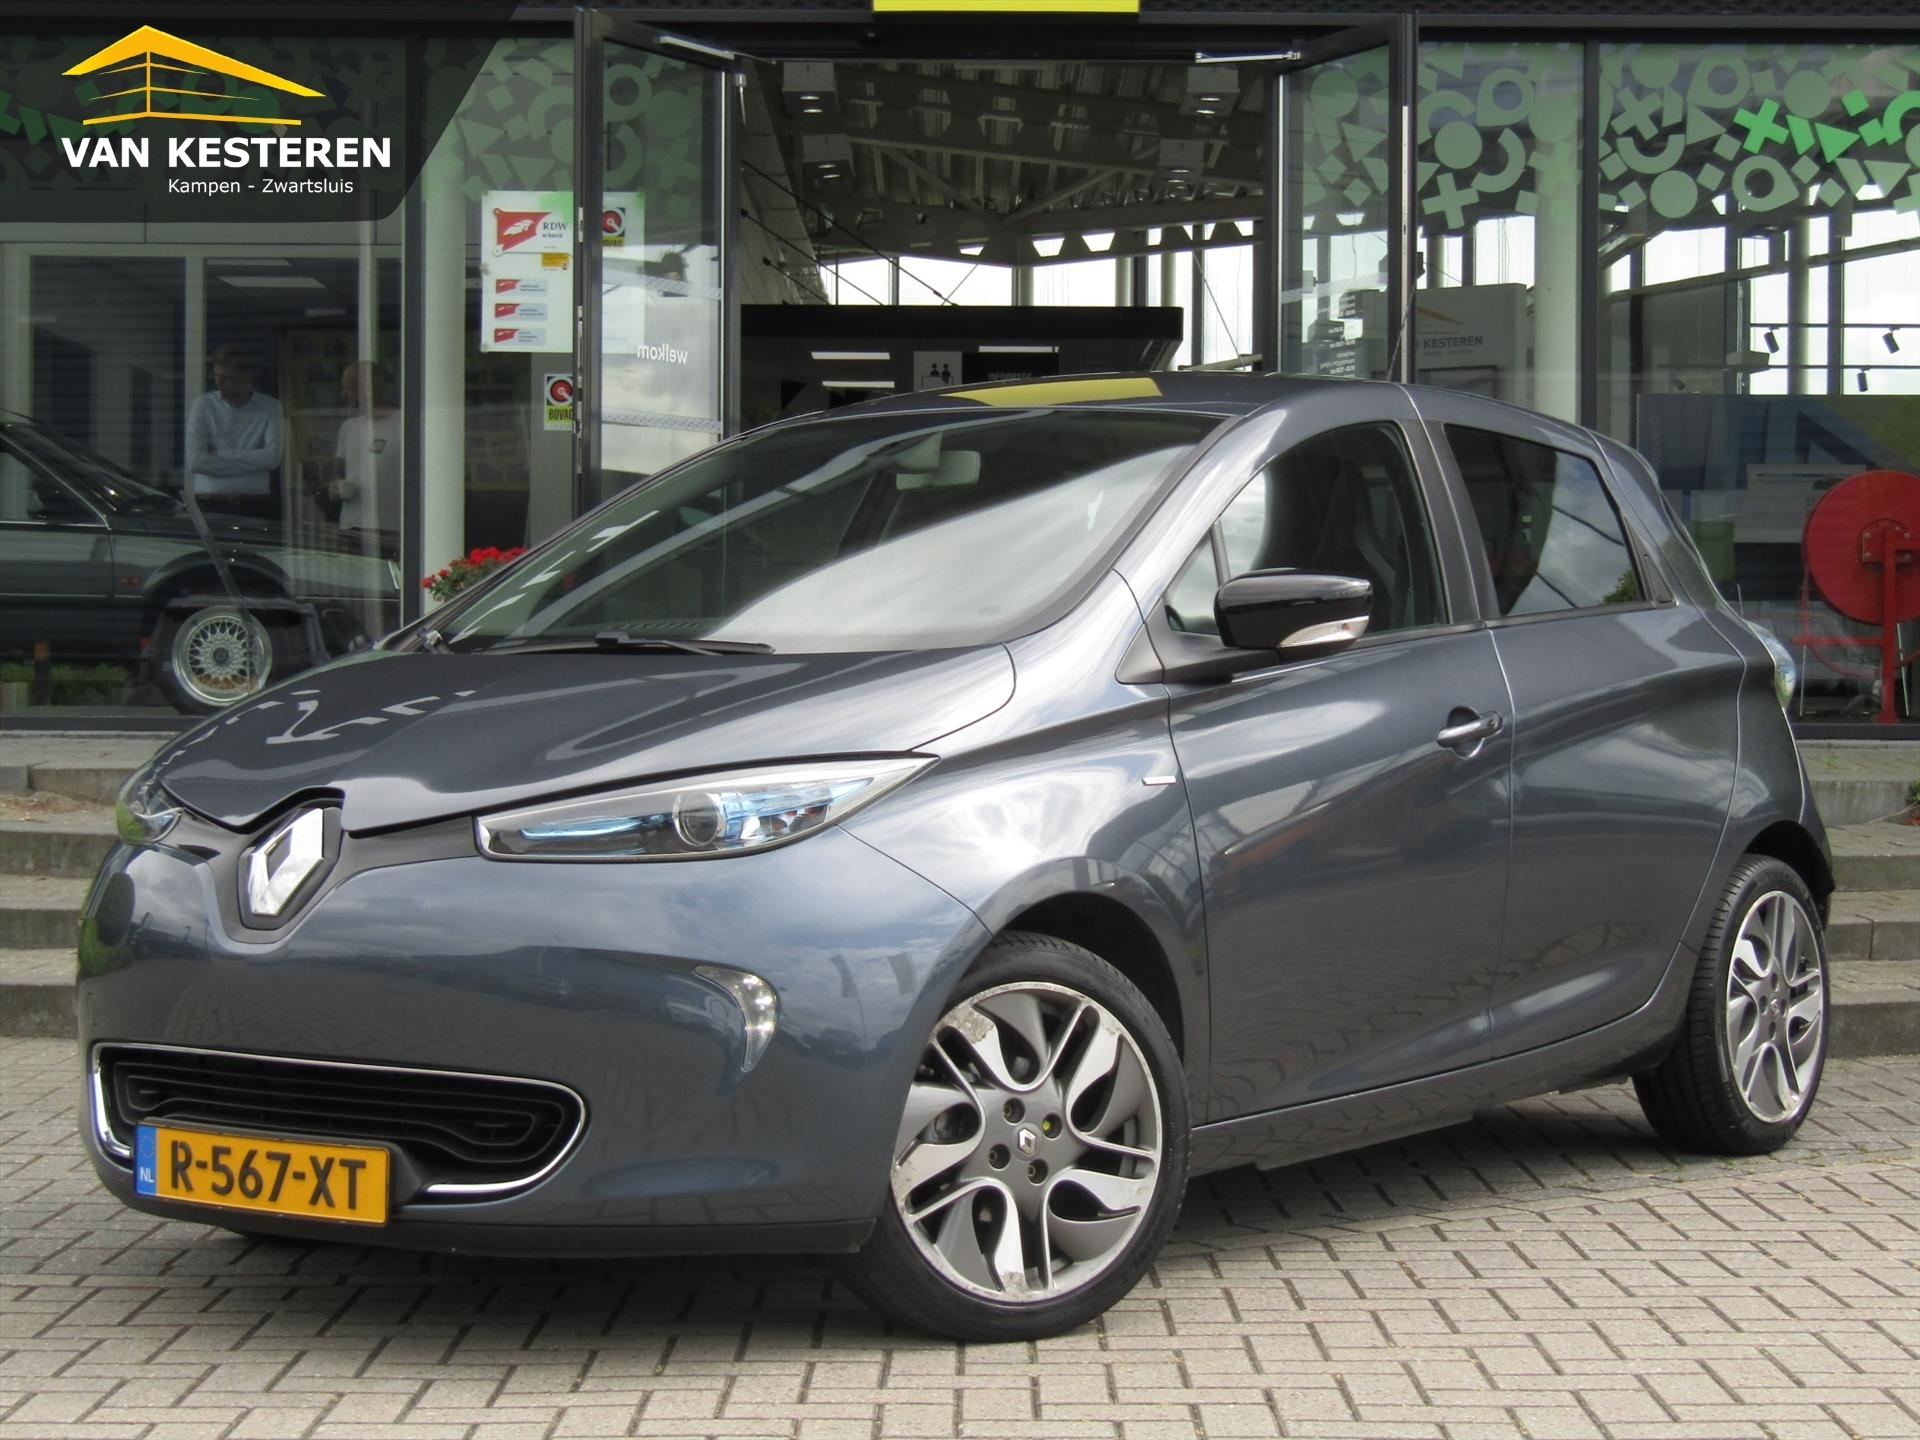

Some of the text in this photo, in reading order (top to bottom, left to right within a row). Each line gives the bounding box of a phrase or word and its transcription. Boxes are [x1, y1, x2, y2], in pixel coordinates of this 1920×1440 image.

[543, 222, 568, 231] RDW
[1424, 336, 1483, 349] KESTEREN
[139, 1166, 155, 1183] NL
[170, 1139, 367, 1210] R-567-XT
